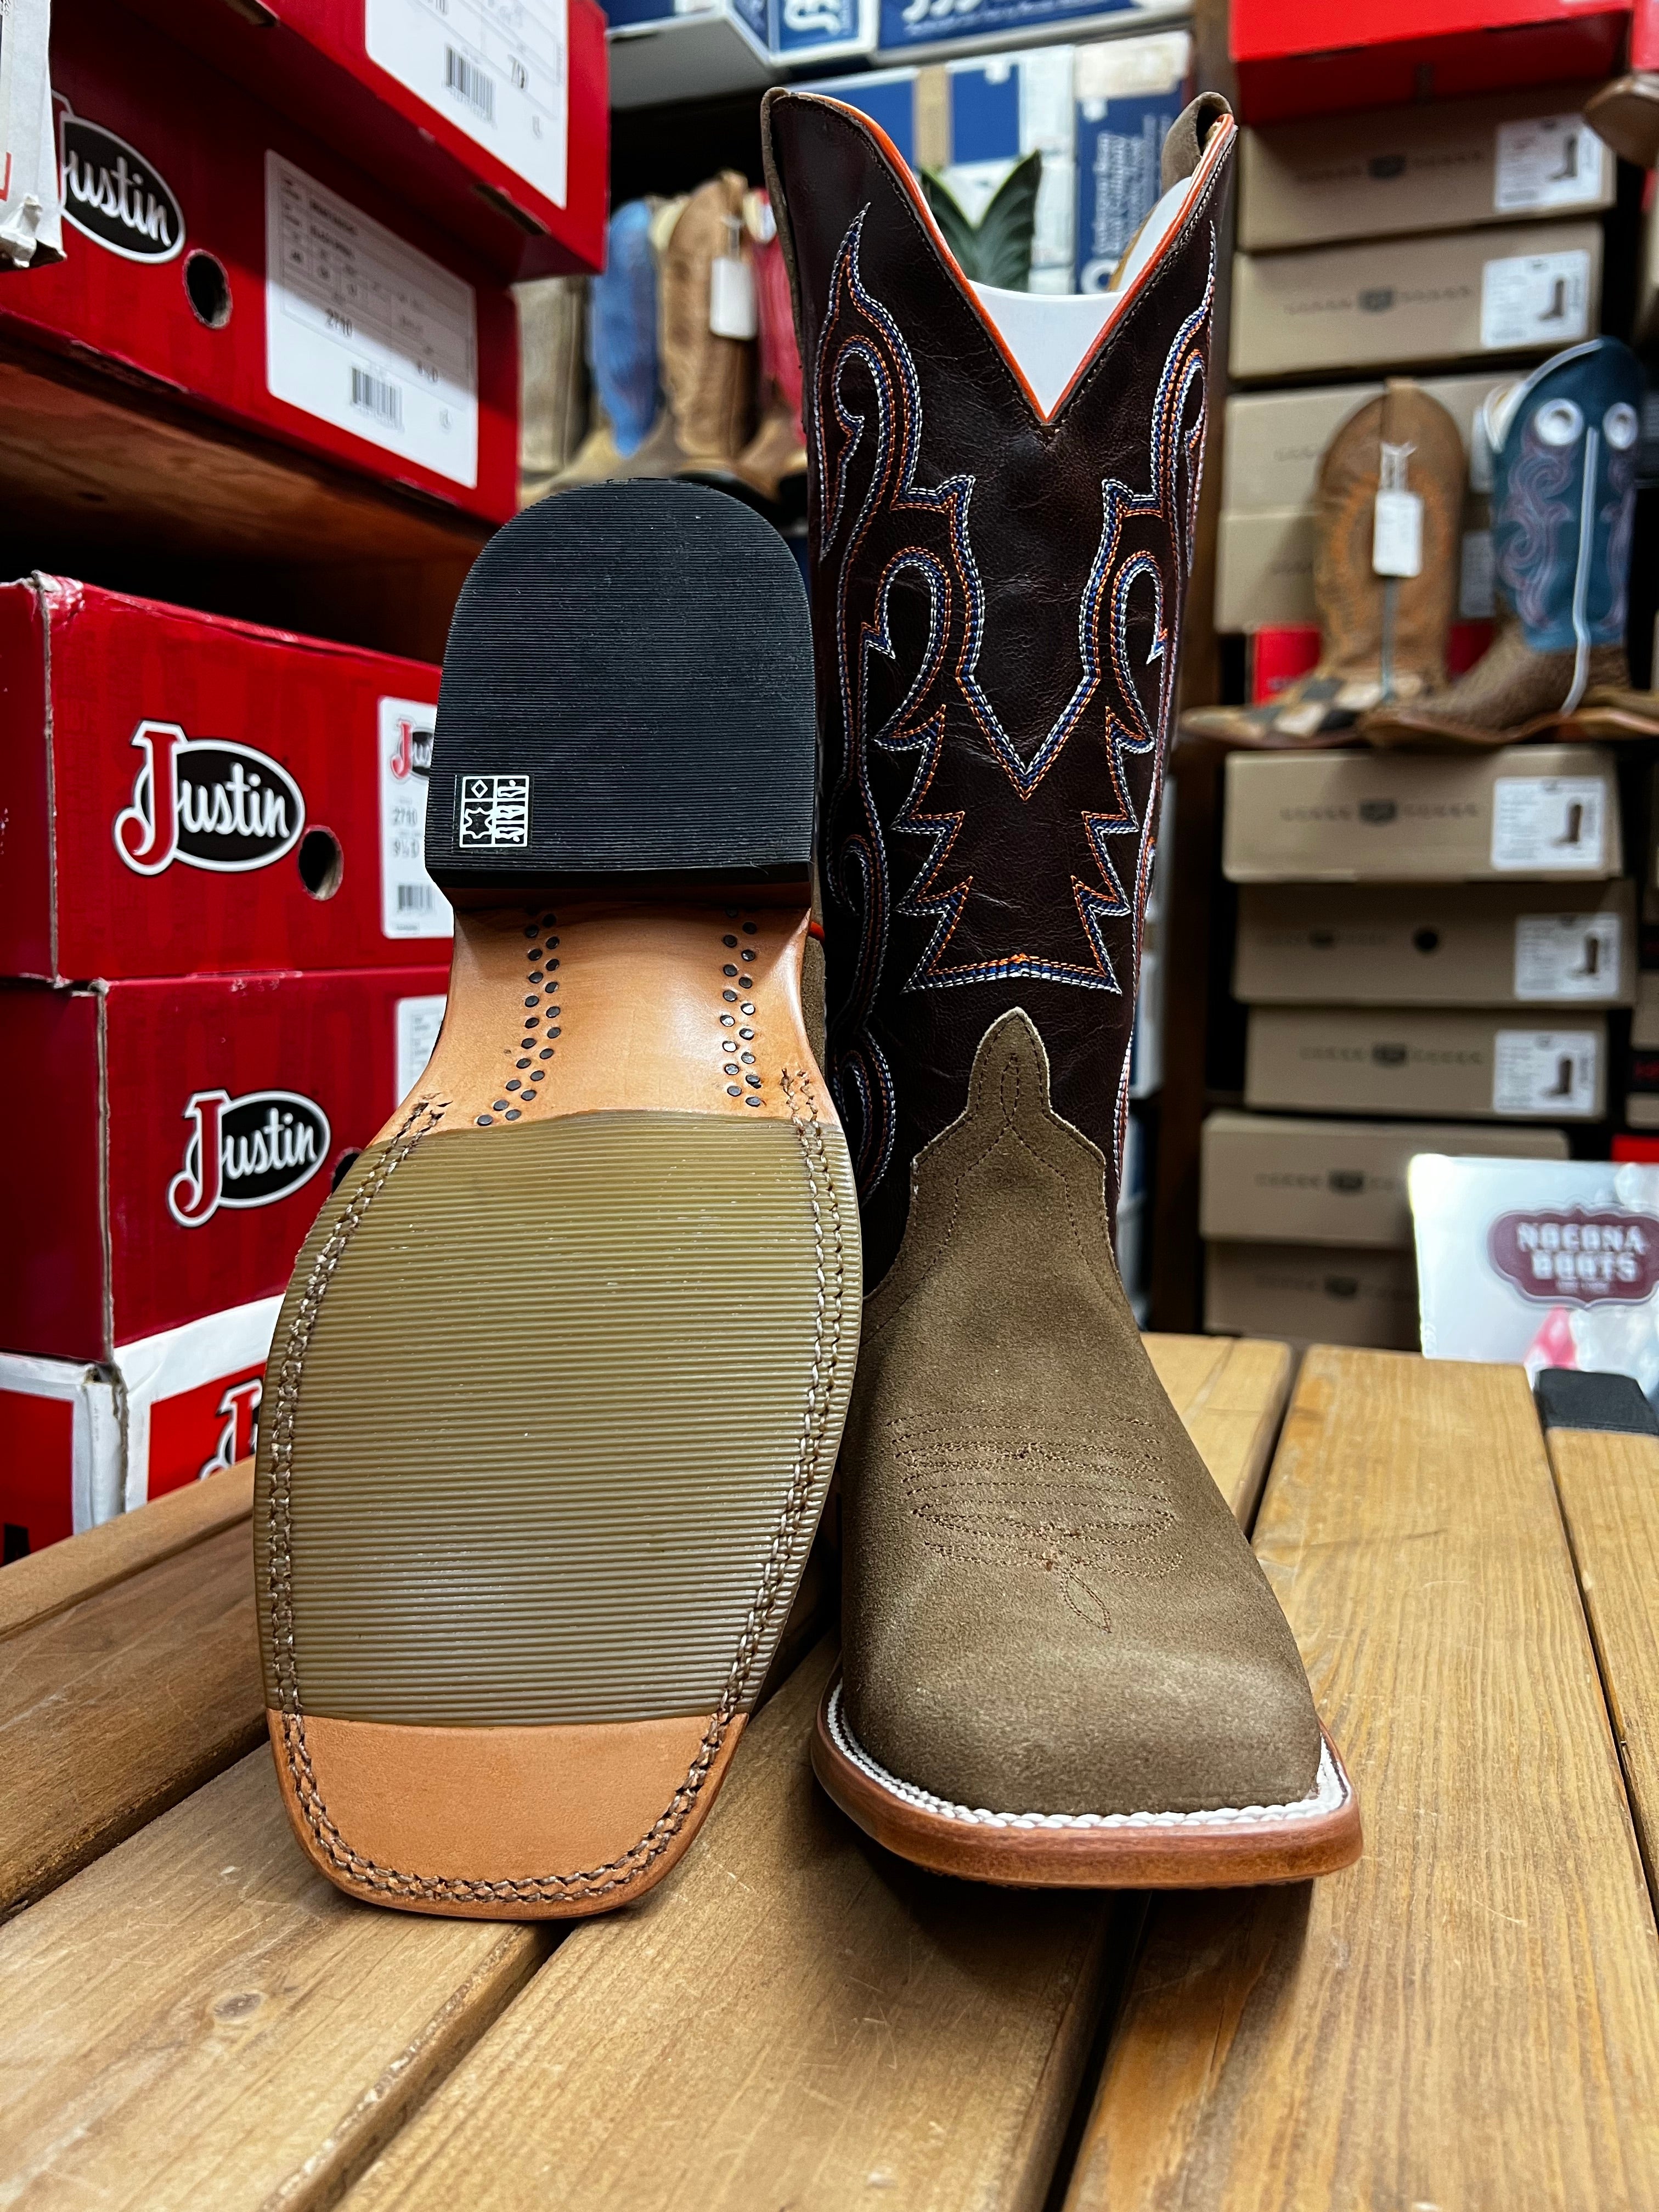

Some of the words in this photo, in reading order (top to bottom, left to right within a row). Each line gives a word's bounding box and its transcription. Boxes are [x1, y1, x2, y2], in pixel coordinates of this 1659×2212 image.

[63, 149, 172, 247] ustin
[114, 721, 291, 875] Justin
[168, 1090, 317, 1227] Justin
[1517, 1222, 1648, 1256] NOCONA
[1531, 1249, 1638, 1283] BOOTS
